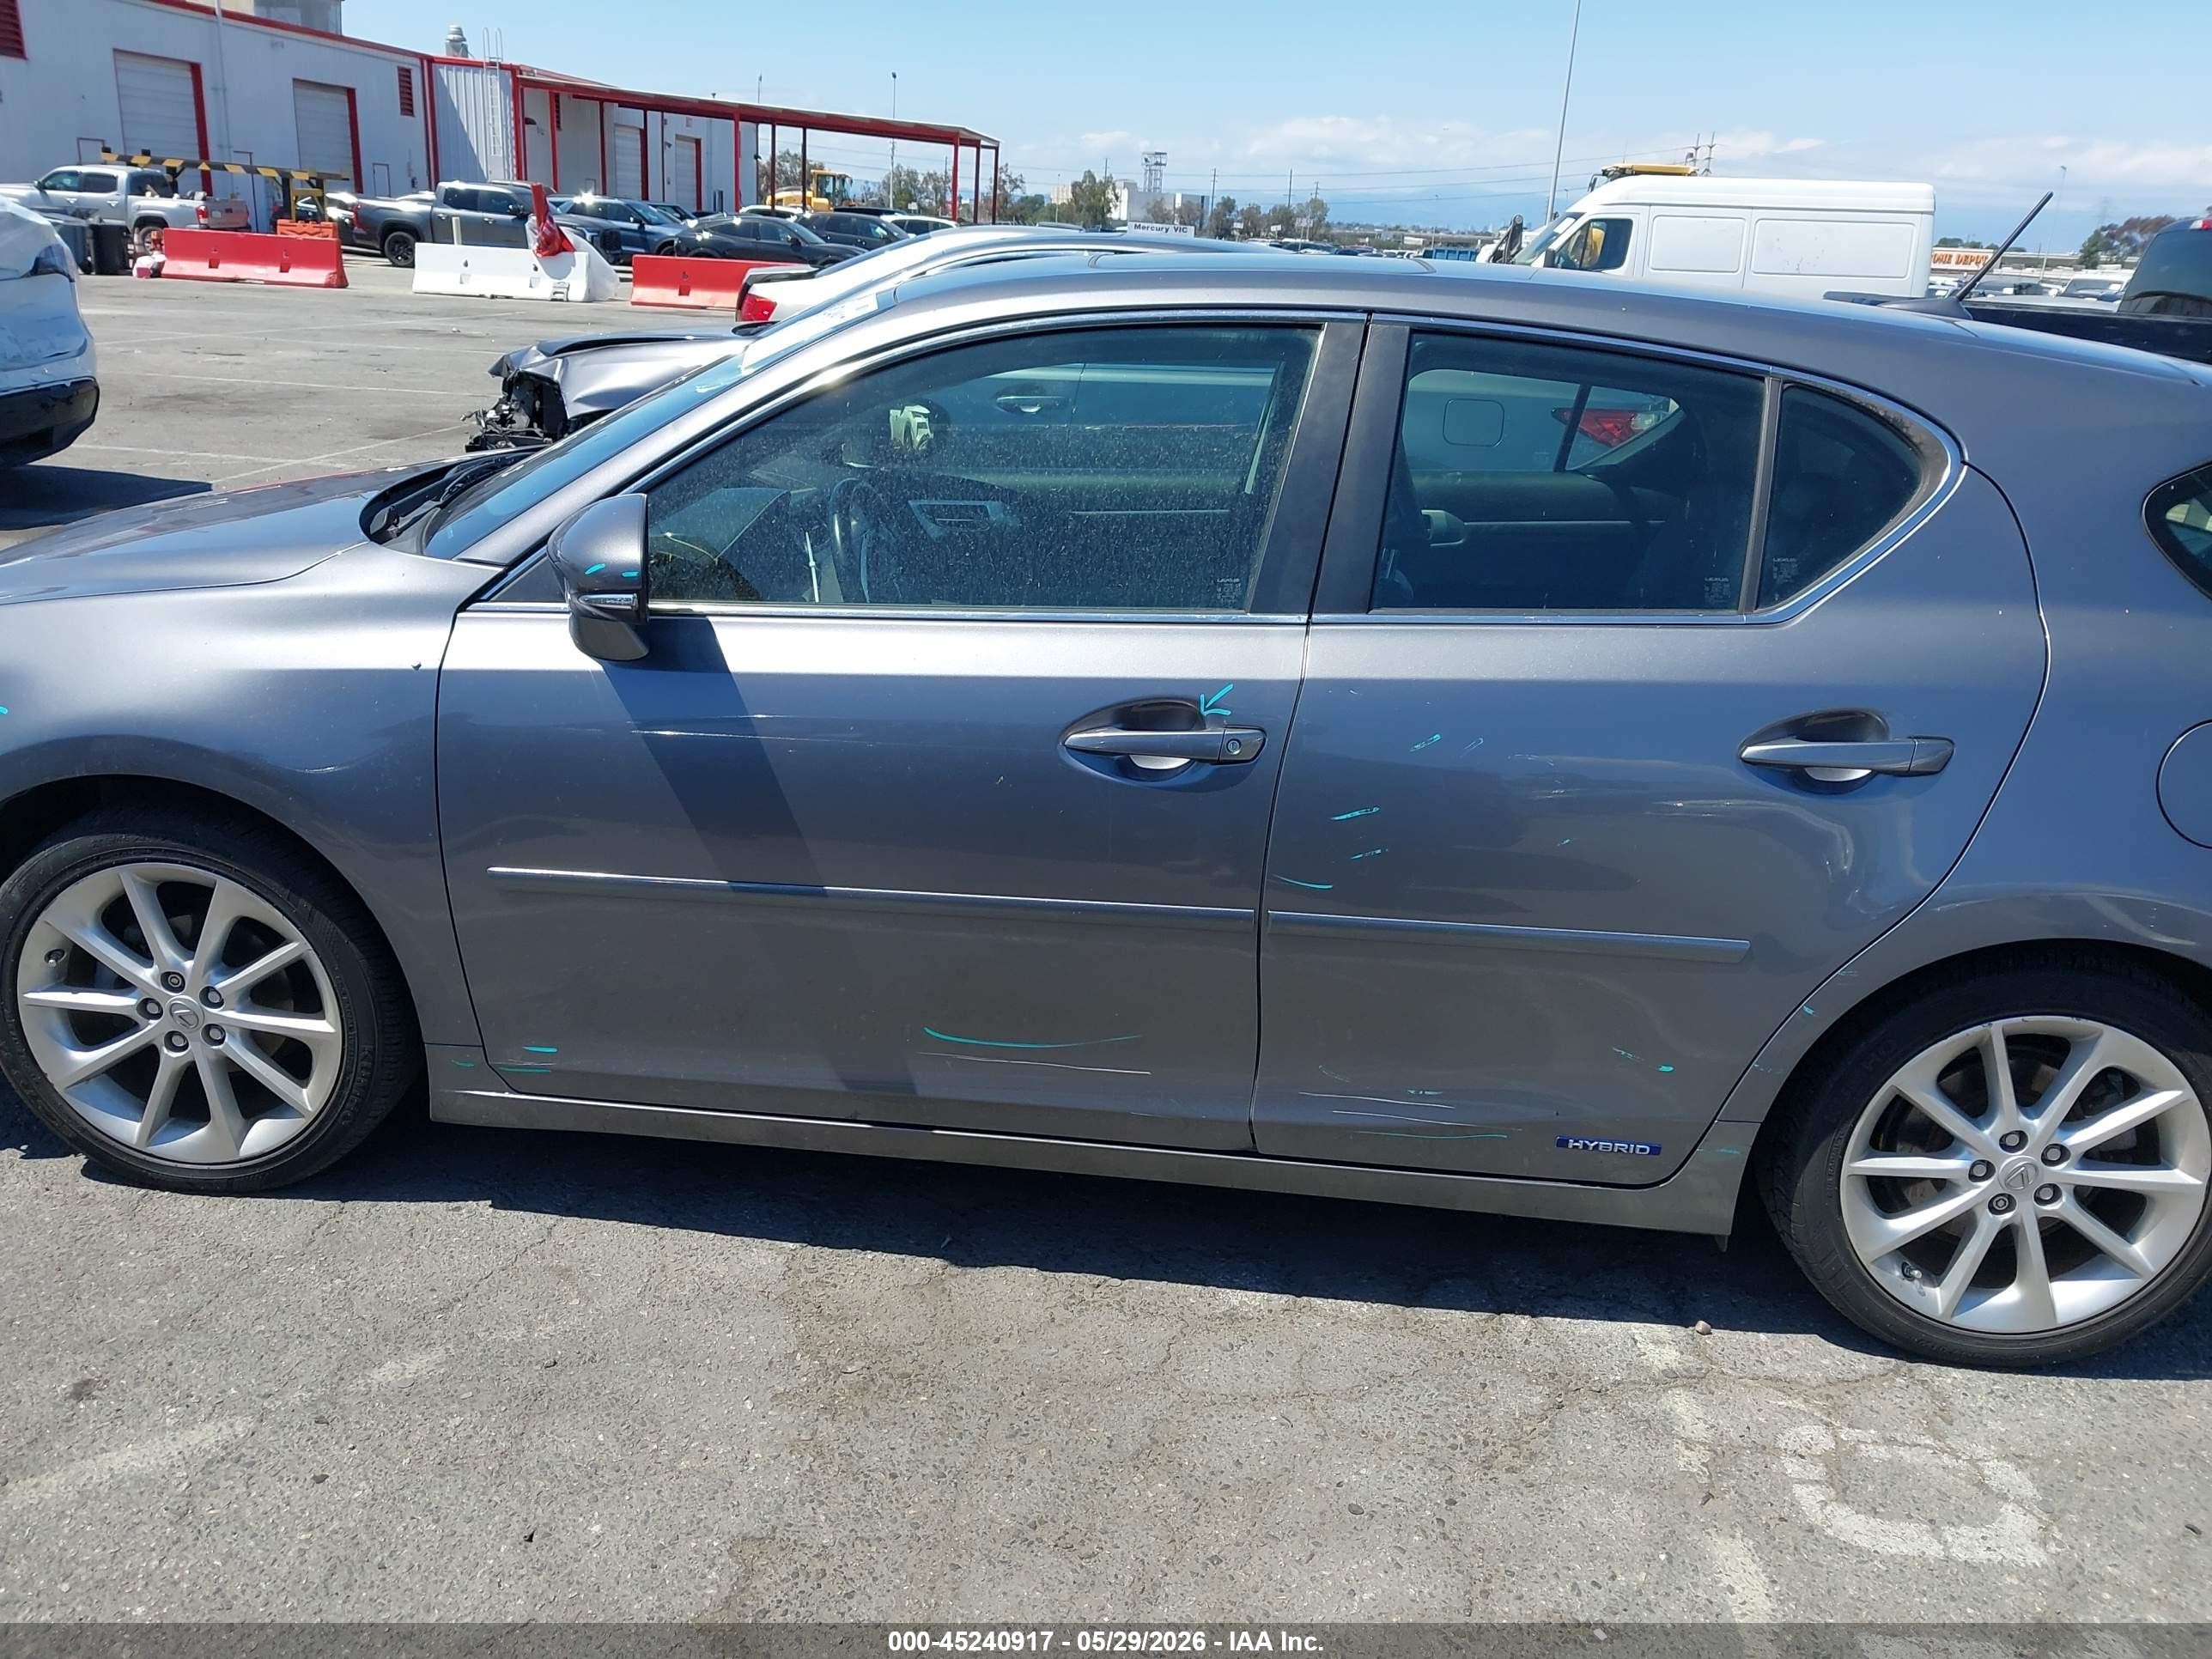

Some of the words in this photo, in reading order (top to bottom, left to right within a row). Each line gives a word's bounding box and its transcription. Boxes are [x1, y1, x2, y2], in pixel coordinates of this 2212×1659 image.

[1133, 223, 1170, 234] Mercury
[1931, 252, 1952, 264] OME
[1567, 1138, 1651, 1156] HYBRID
